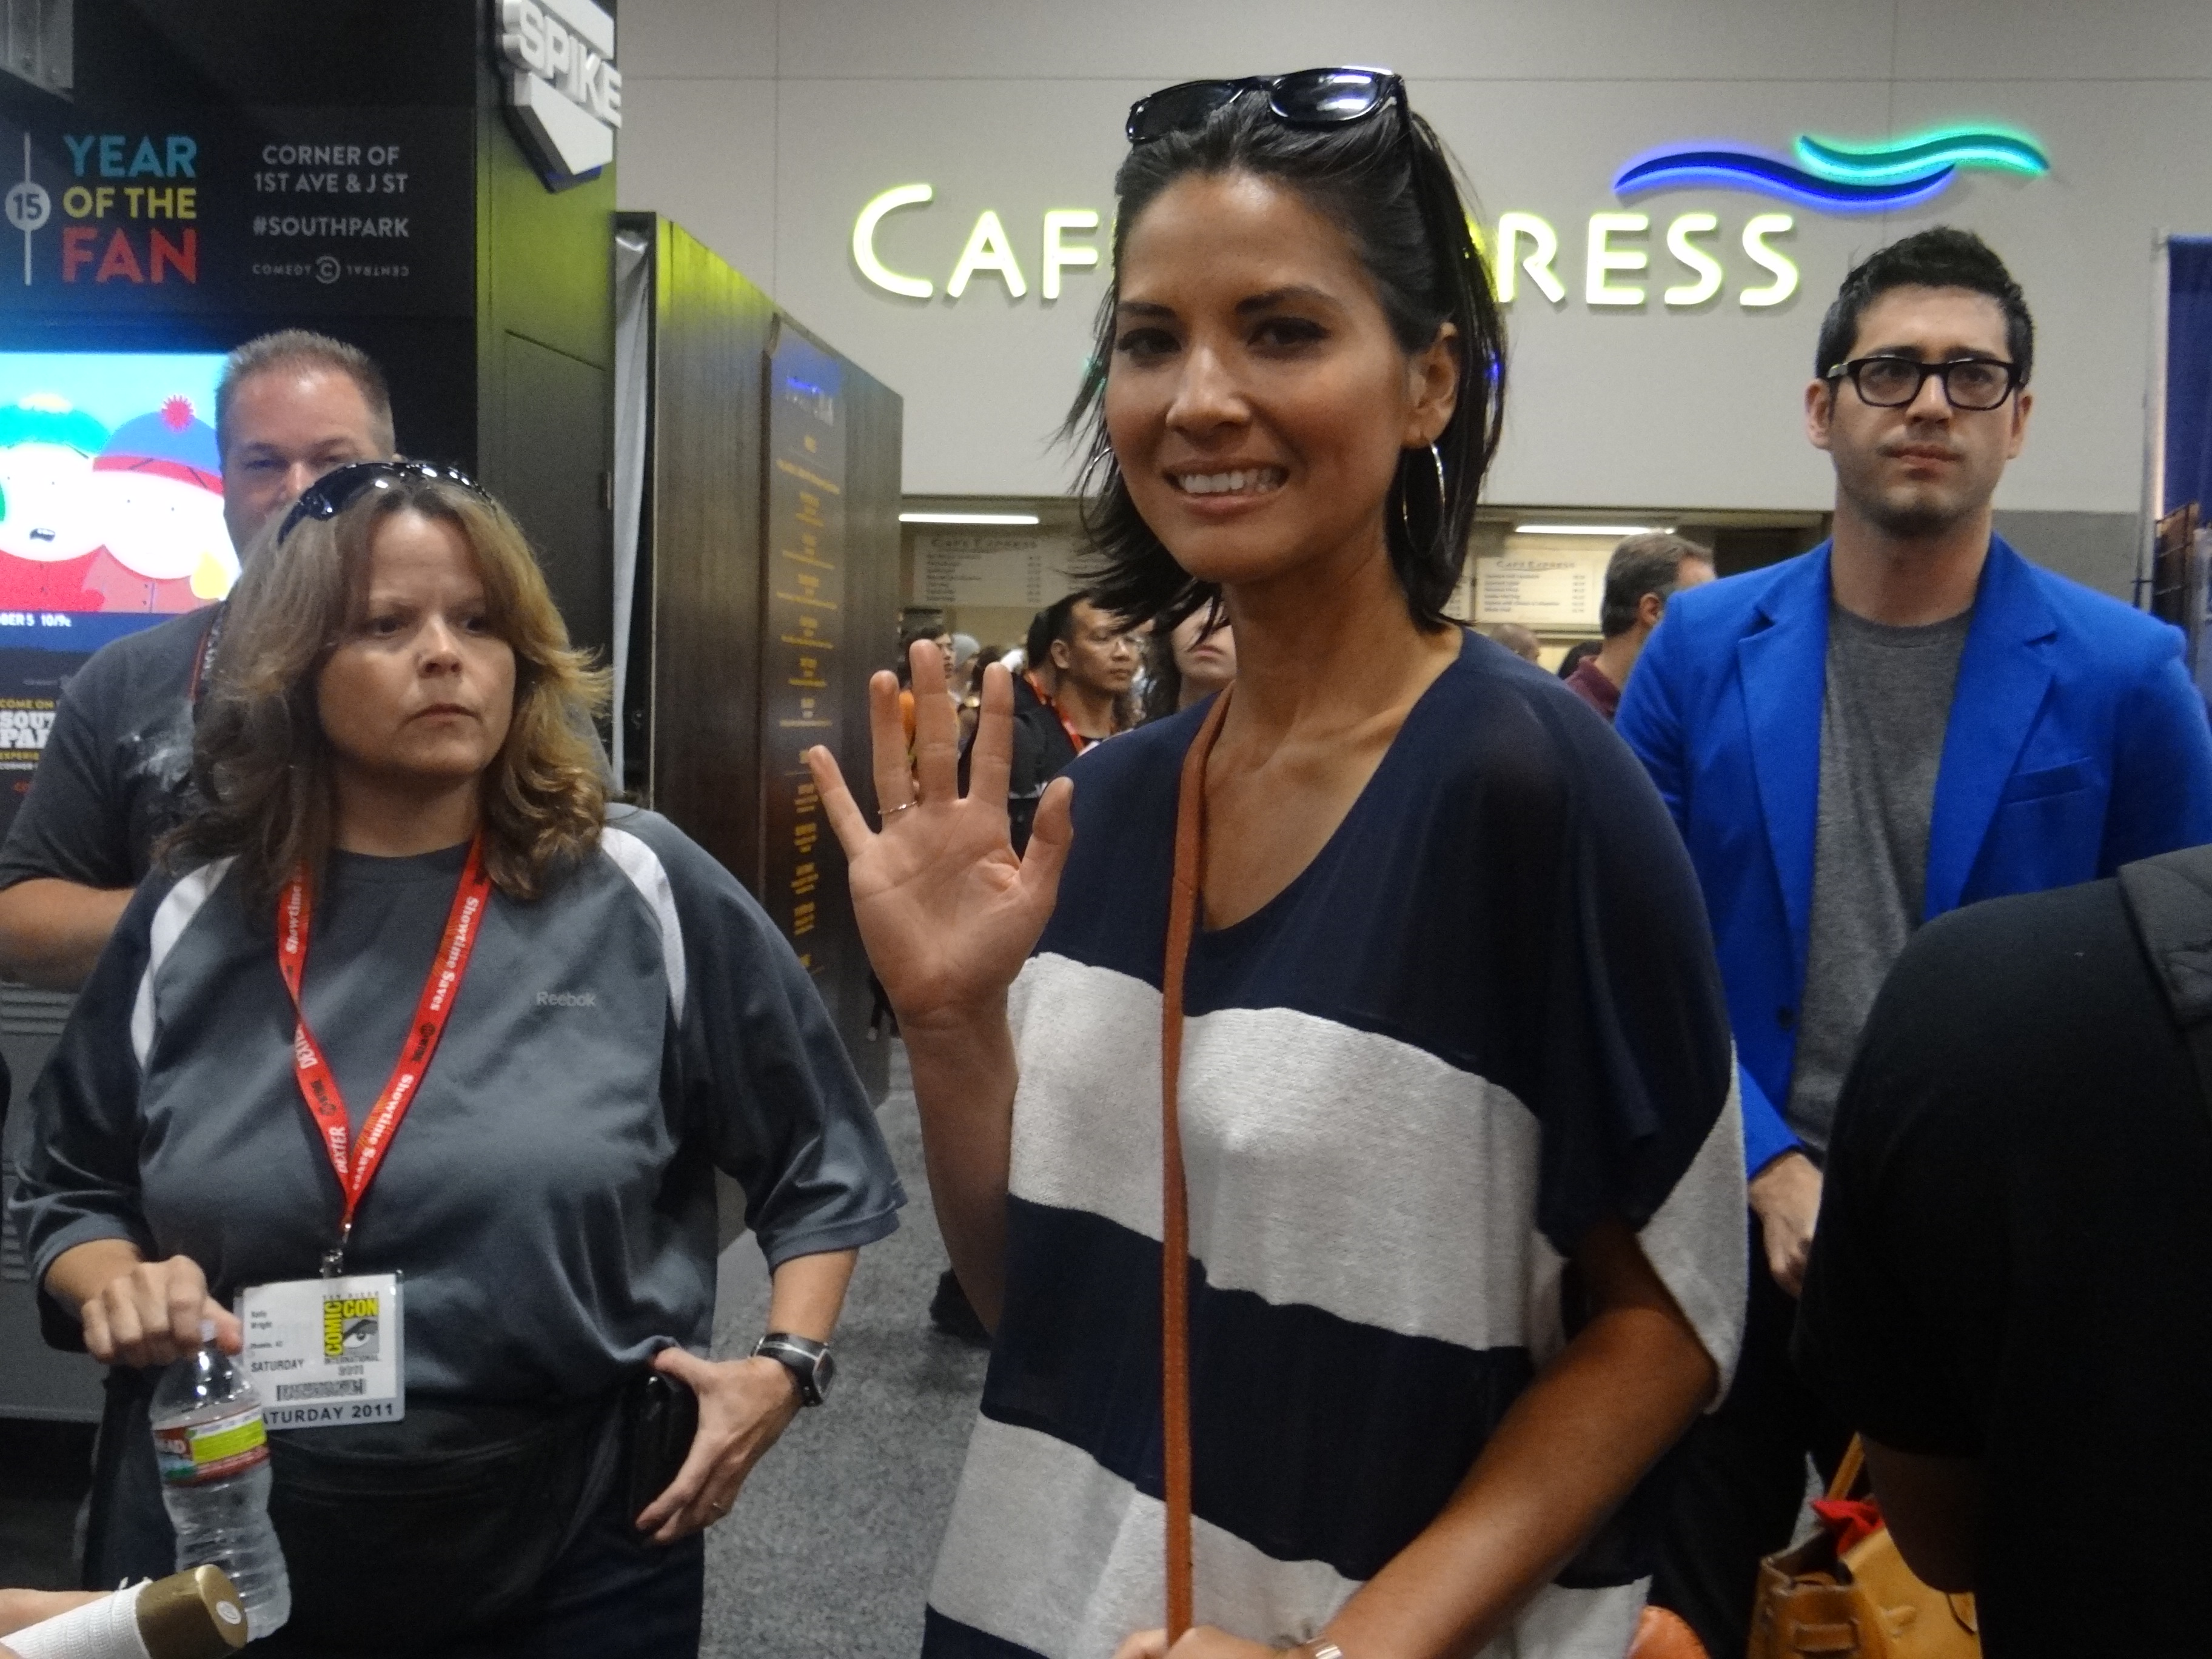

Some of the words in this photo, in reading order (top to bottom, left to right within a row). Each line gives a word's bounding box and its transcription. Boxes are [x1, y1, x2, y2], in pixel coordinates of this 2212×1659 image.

[503, 0, 622, 129] SPIKE
[63, 134, 197, 178] YEAR
[261, 145, 361, 166] CORNER
[367, 146, 400, 166] OF
[253, 172, 289, 193] 1ST
[295, 172, 339, 193] AVE
[345, 173, 361, 193] &
[366, 173, 377, 193] J
[382, 173, 409, 193] ST
[12, 192, 42, 220] 15
[63, 186, 115, 219] OF
[124, 187, 197, 220] THE
[253, 216, 409, 237] #SOUTHPARK
[62, 226, 198, 285] FAN
[853, 184, 1117, 300] CAF
[1467, 212, 1800, 306] RESS
[0, 612, 25, 626] BER
[446, 896, 480, 969] Showtime
[429, 971, 455, 1011] Saves
[536, 991, 597, 1007] Reebok
[367, 1074, 414, 1145] Showtime
[329, 1126, 349, 1173] DEXTER
[343, 1298, 379, 1318] CON
[324, 1301, 343, 1356] COMIC
[251, 1359, 304, 1372] SATURDAY
[262, 1406, 344, 1425] TURDAY
[352, 1403, 394, 1419] 2011
